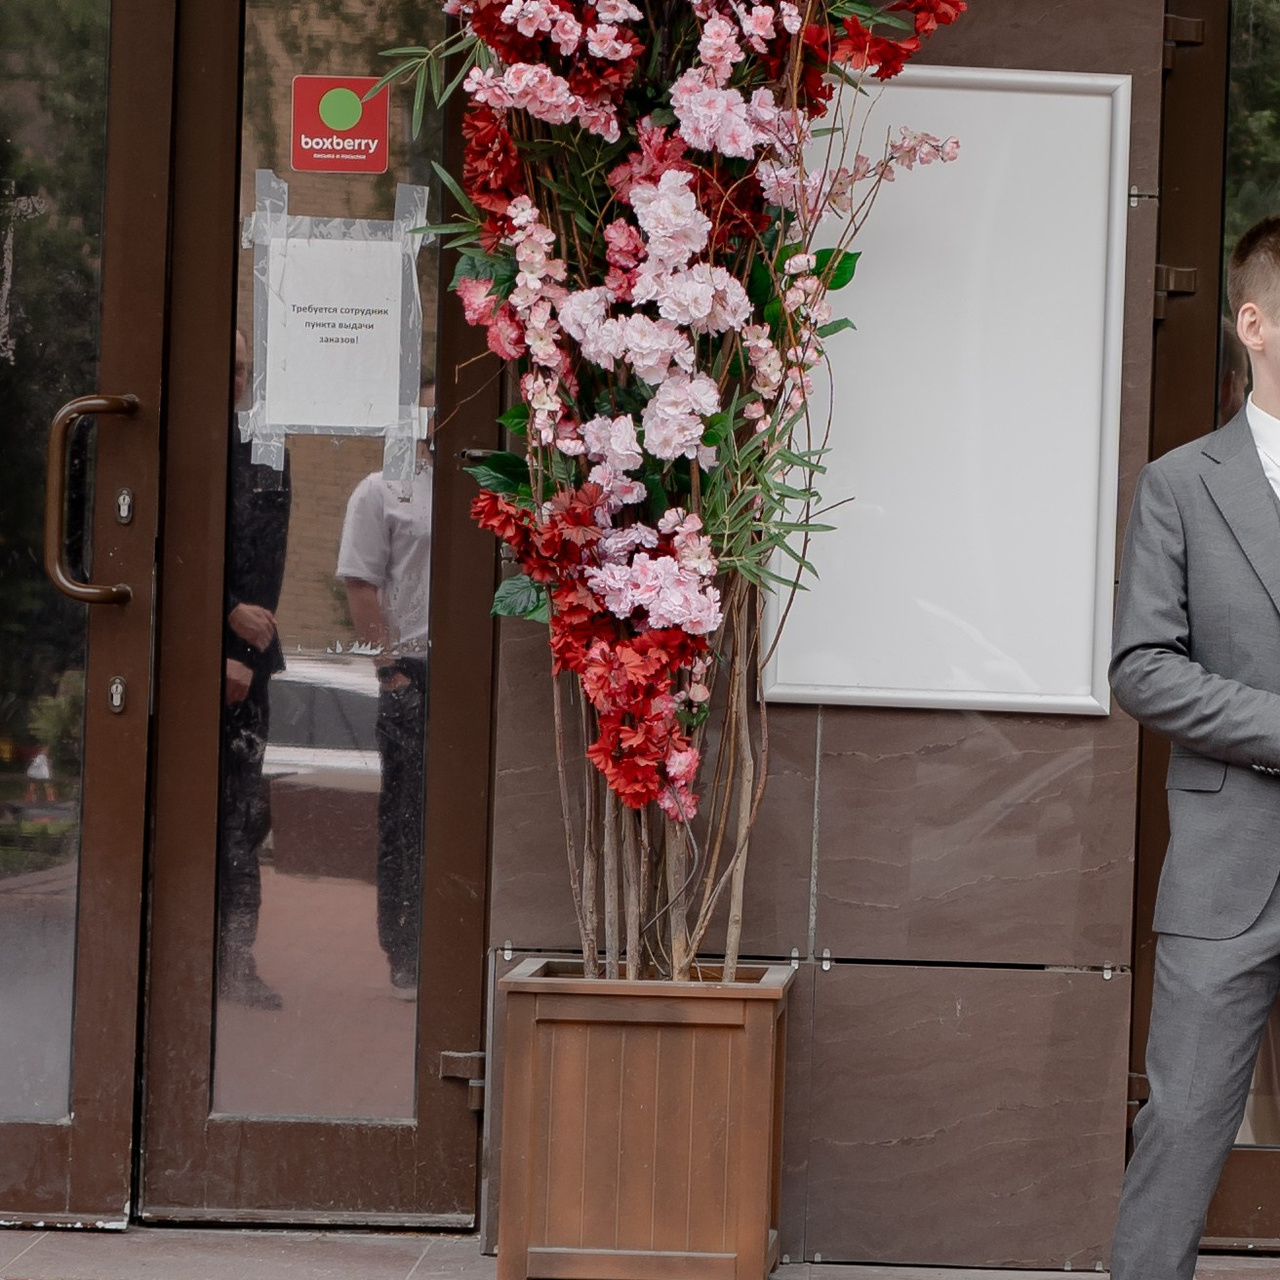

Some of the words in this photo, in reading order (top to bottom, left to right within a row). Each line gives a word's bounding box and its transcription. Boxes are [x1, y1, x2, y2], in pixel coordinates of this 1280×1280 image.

[301, 134, 378, 153] boxberry
[291, 304, 338, 316] Требуется
[339, 306, 389, 317] сотрудник
[304, 321, 336, 330] пункта
[338, 322, 374, 331] выдачи
[319, 336, 359, 344] заказов!
